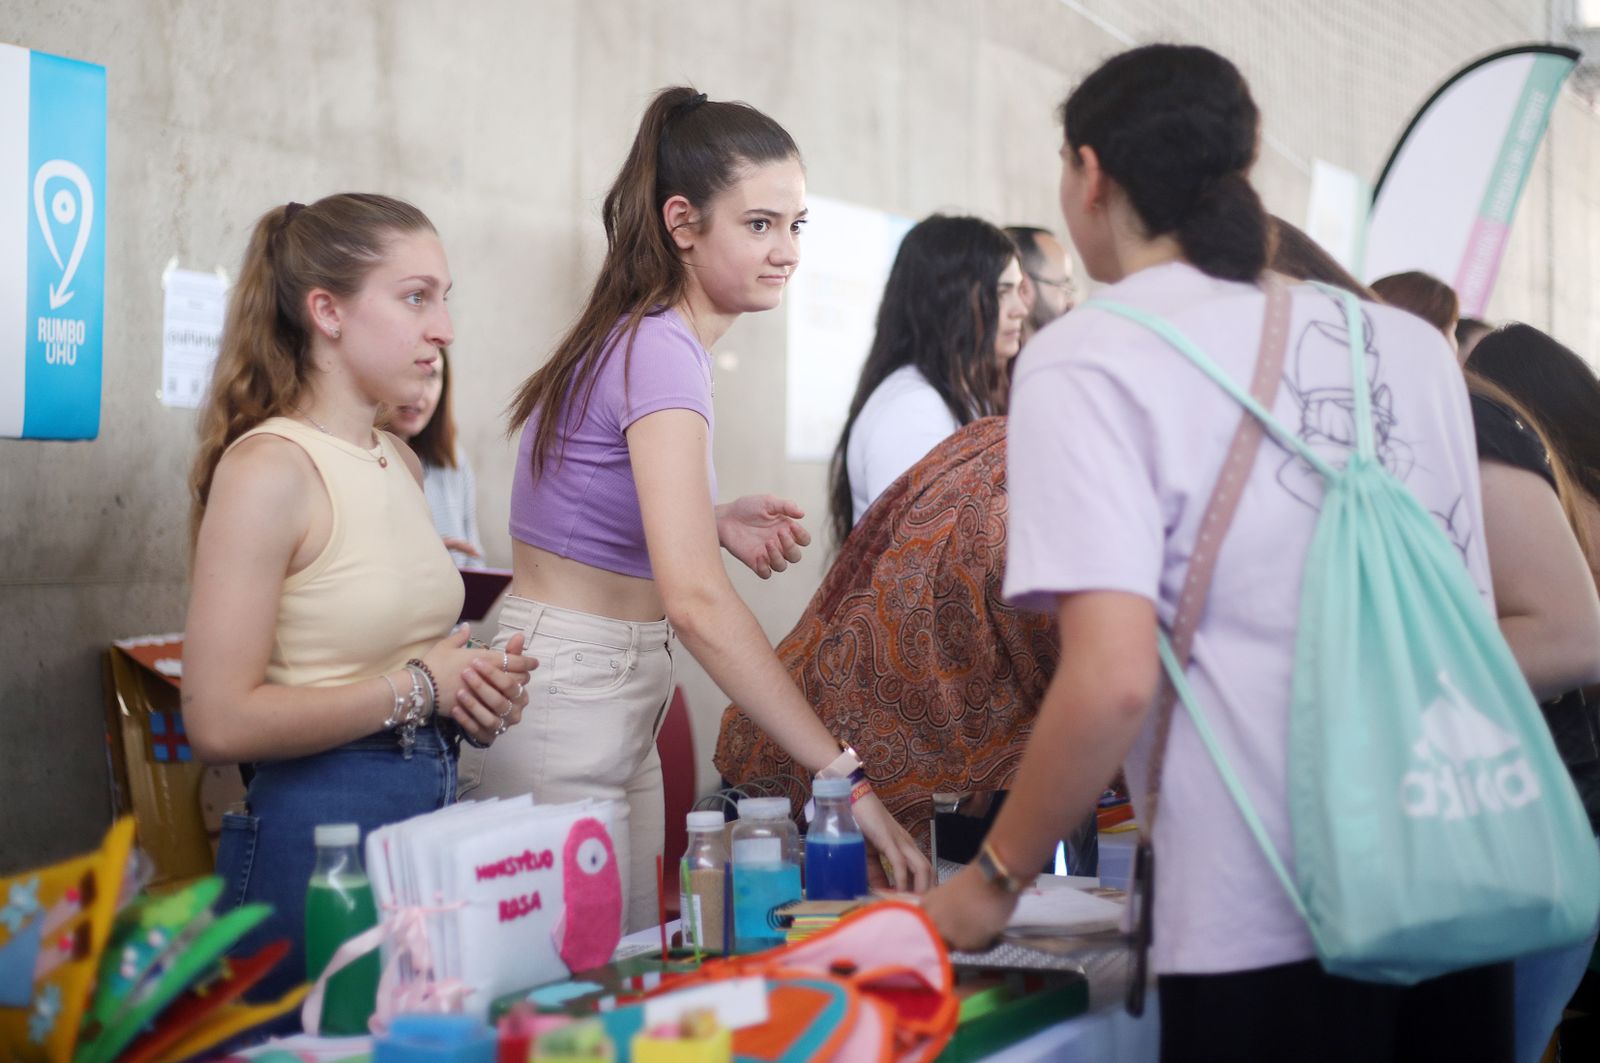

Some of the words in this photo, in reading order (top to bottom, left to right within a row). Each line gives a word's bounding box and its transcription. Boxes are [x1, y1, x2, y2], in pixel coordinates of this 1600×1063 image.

[38, 317, 85, 346] RUMBO
[45, 342, 77, 366] UHU
[498, 890, 542, 924] ROSA
